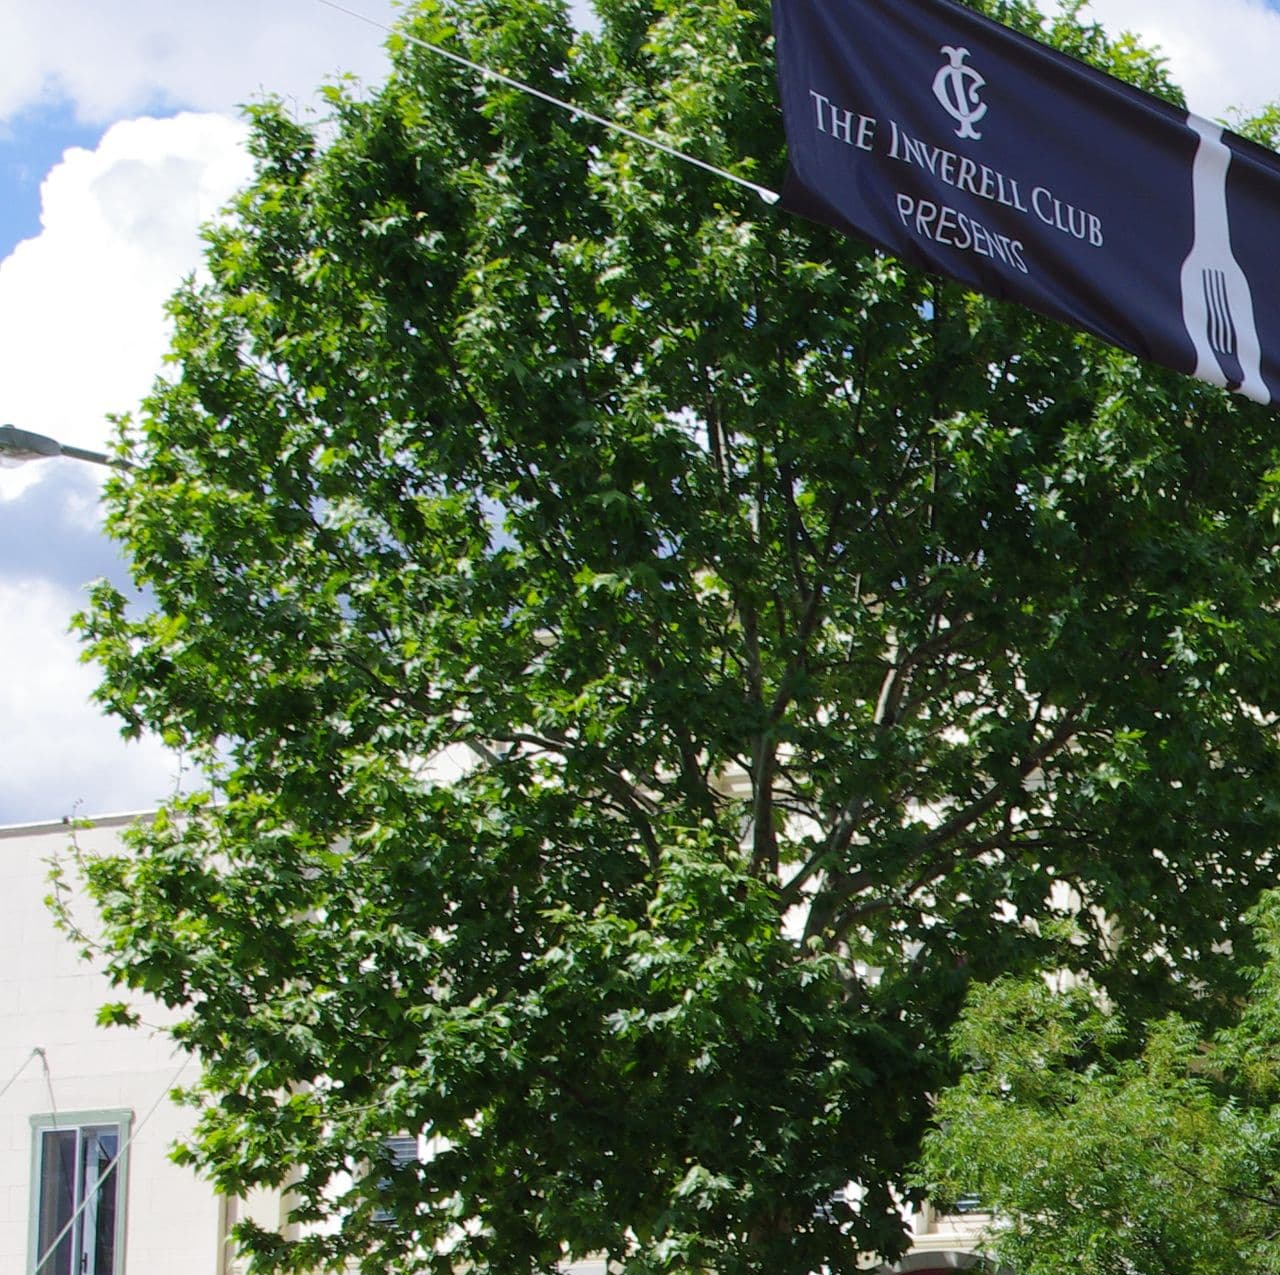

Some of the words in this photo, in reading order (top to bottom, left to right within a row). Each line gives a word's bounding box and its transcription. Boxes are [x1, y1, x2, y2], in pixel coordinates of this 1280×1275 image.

[808, 89, 877, 153] THE
[886, 119, 1029, 213] INVERELL
[1032, 186, 1104, 249] CLUB
[896, 192, 1030, 275] PRESENTS
